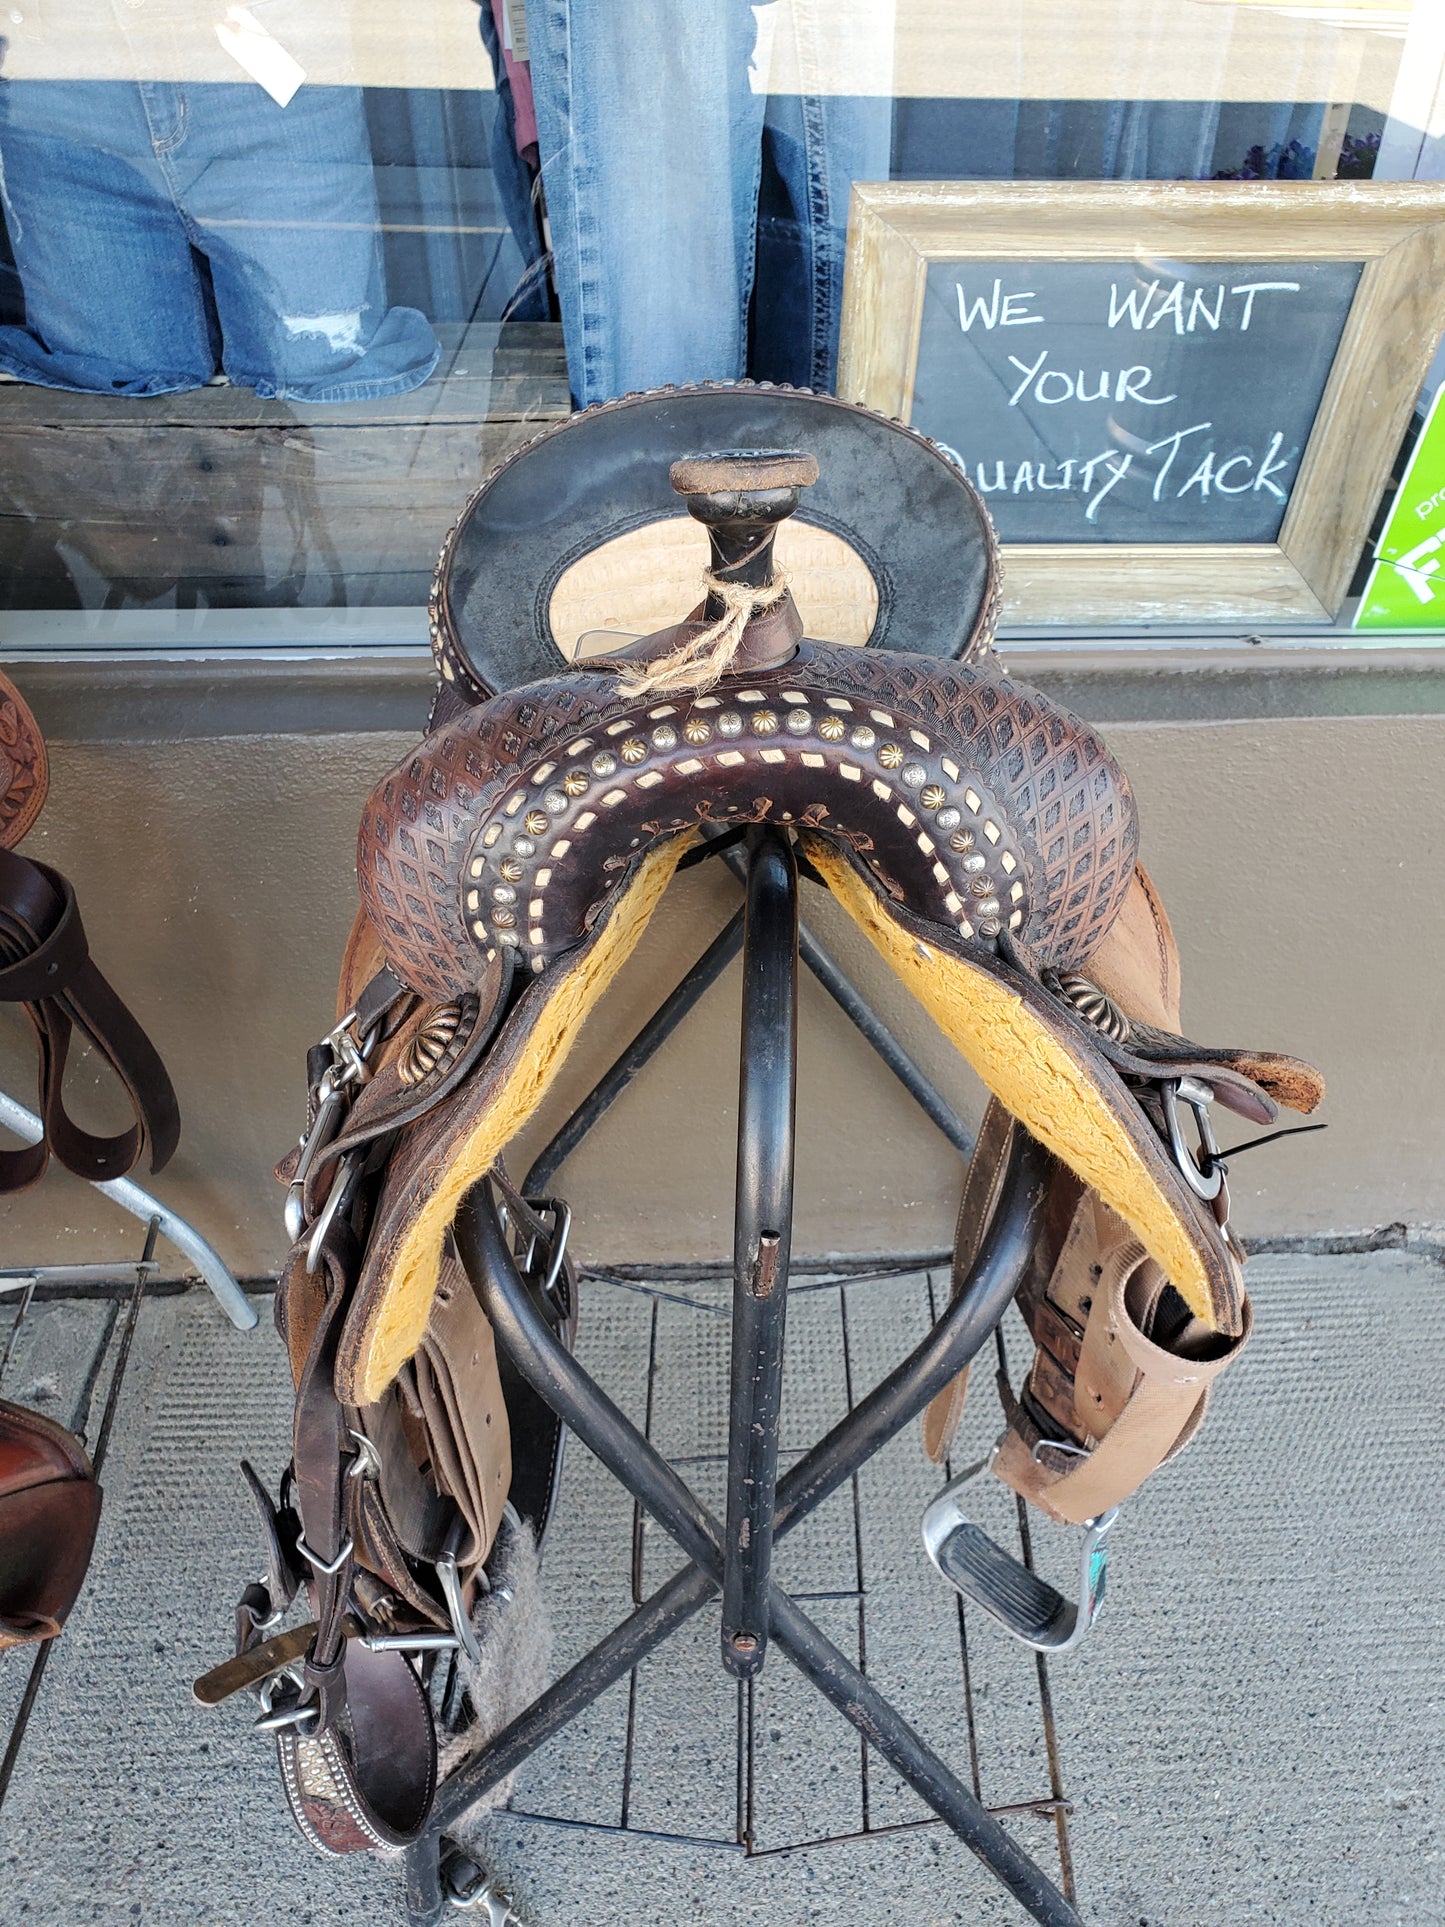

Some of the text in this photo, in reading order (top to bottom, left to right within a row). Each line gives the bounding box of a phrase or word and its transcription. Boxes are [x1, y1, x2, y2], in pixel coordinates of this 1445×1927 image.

[956, 278, 1300, 335] WE WANT
[1008, 350, 1178, 407] YOUR
[1146, 422, 1289, 501] TACK
